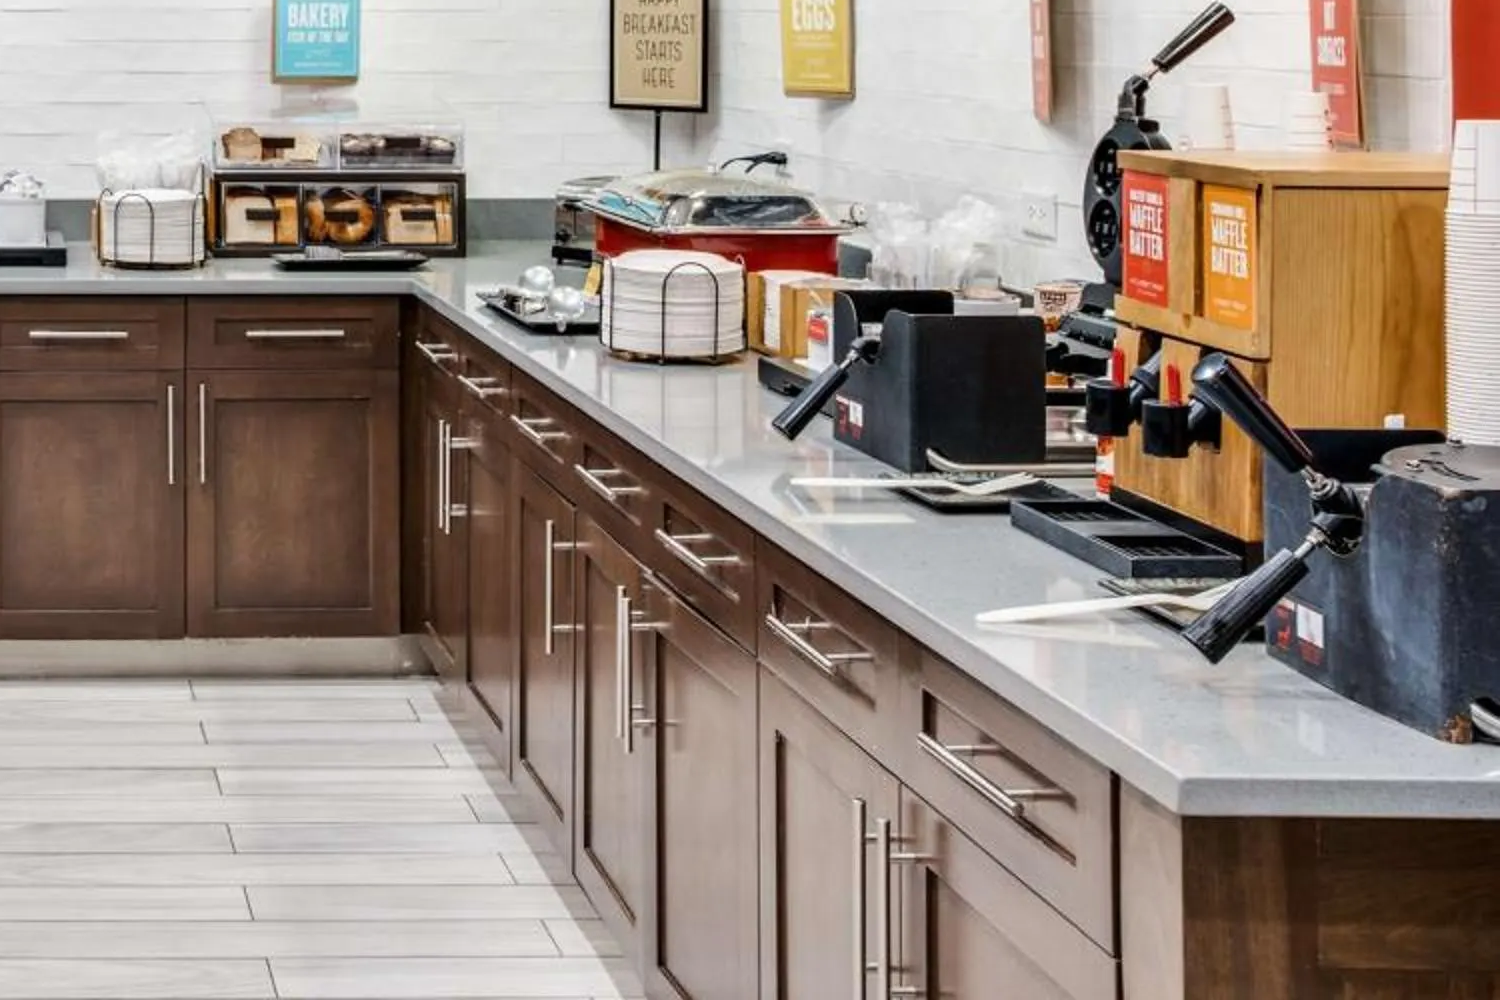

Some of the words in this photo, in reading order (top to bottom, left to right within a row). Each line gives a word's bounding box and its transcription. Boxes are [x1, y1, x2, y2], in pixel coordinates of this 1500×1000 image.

[288, 1, 350, 29] BAKERY
[623, 13, 696, 35] BREAKFAST
[635, 39, 683, 61] STARTS
[642, 67, 677, 89] HERE
[1129, 202, 1165, 234] WAFFLE
[1211, 215, 1249, 250] WAFFLE
[1129, 229, 1164, 261] BATTER
[1211, 244, 1250, 280] BATTER
